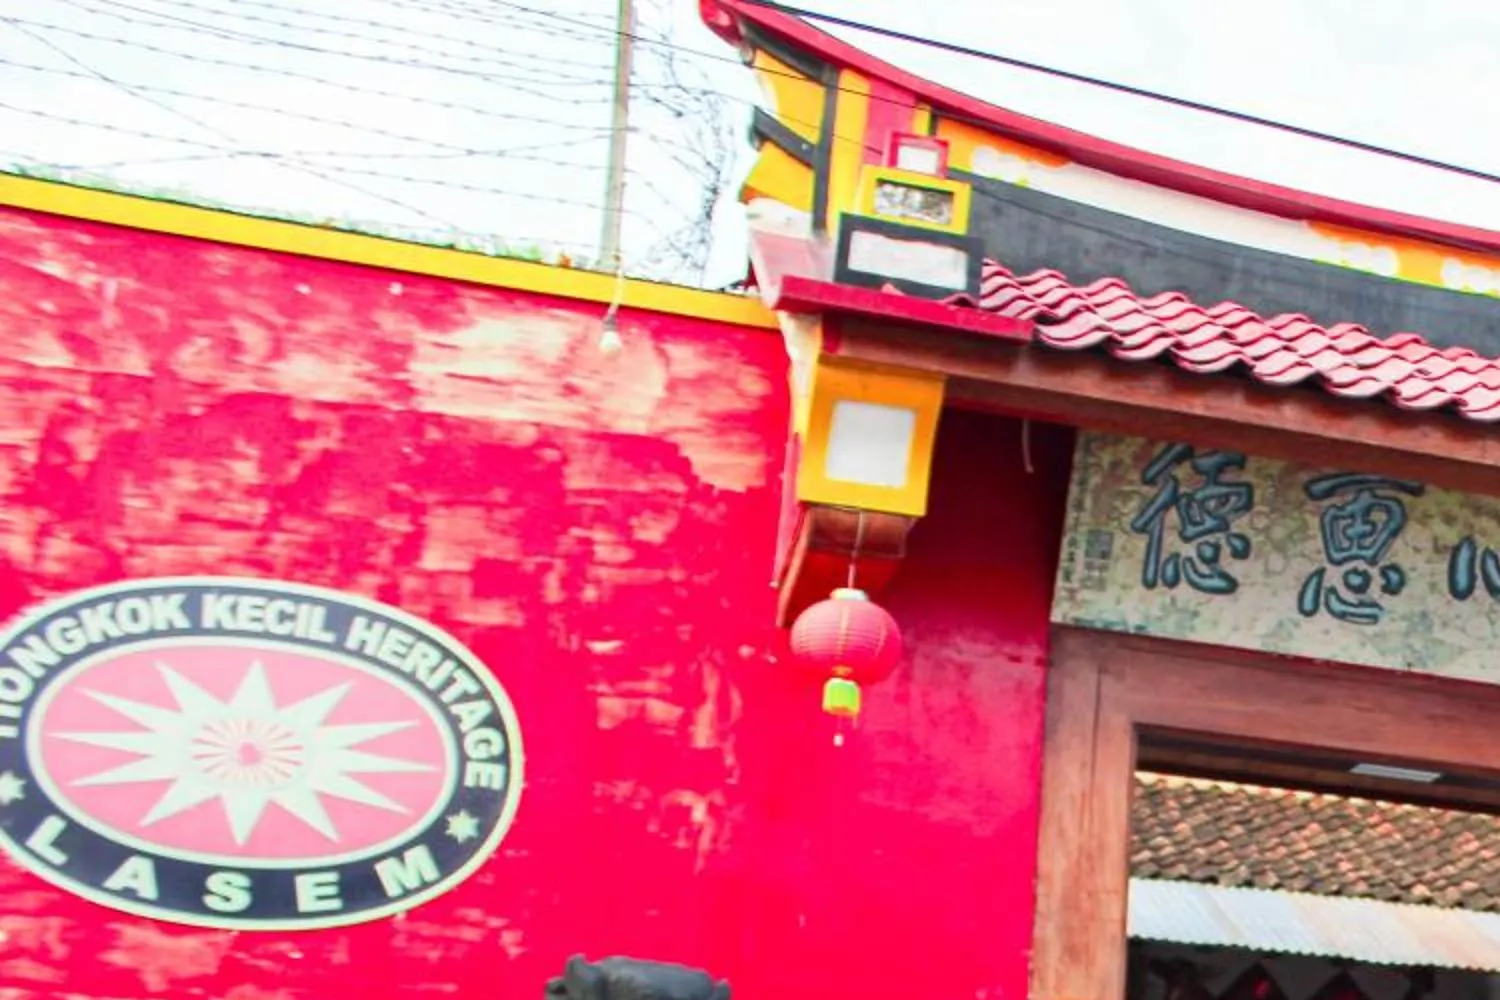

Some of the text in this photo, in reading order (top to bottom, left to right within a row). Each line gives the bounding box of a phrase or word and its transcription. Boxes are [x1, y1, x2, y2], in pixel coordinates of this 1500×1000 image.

[202, 593, 337, 644] KECIL
[345, 618, 507, 790] HERITAGE
[26, 815, 441, 913] LASEM
